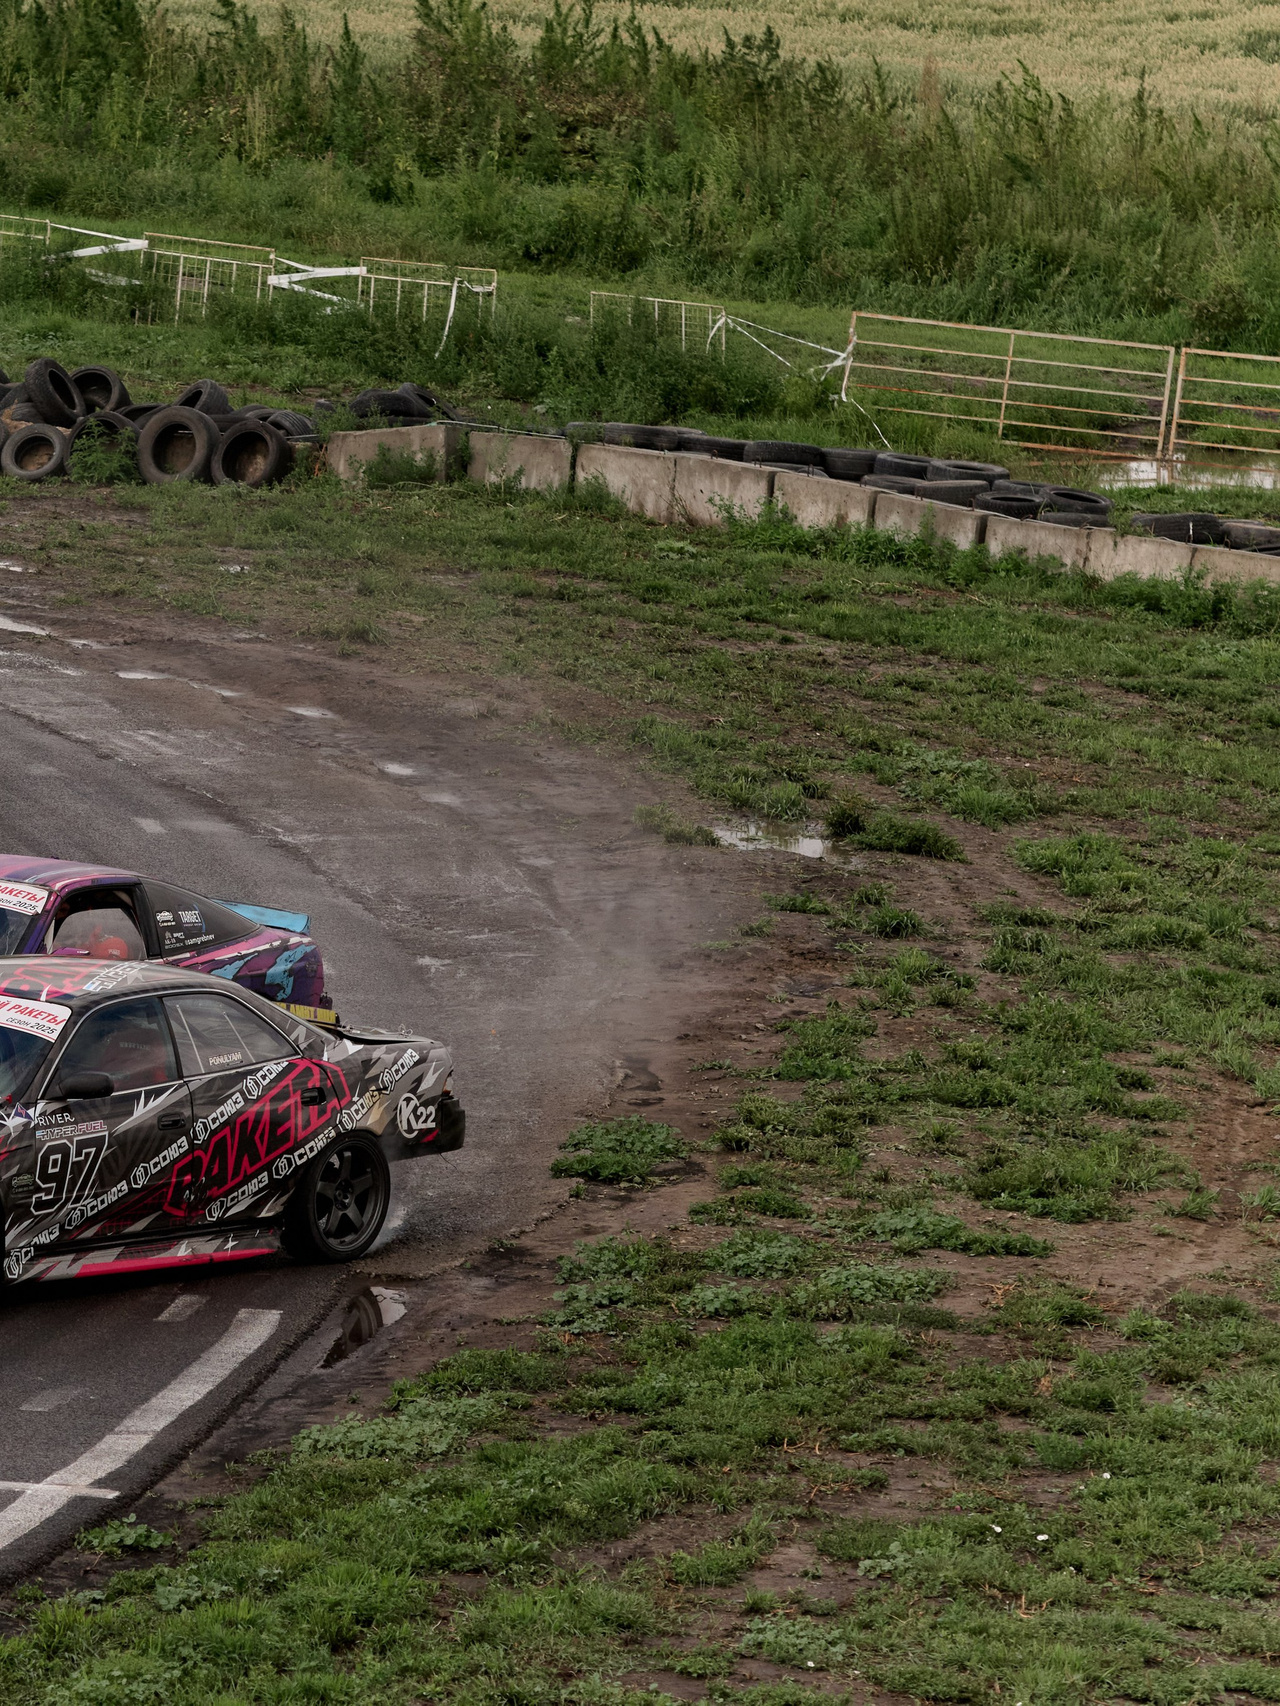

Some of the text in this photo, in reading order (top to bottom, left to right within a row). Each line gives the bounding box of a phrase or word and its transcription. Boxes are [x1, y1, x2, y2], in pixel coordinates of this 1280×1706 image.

[12, 900, 38, 912] 2025
[178, 910, 202, 923] TARGET
[6, 1016, 58, 1035] СЕЗОН 2025
[7, 1003, 67, 1026] РАКЕТЫ
[208, 1051, 242, 1066] PONULYAM
[37, 1112, 75, 1127] RIVER
[208, 1092, 246, 1130] СОЮЗ
[149, 1135, 190, 1175] СОЮЗ
[30, 1131, 109, 1215] 97
[86, 1180, 128, 1218] СОЮЗ
[226, 1171, 269, 1207] СОЮЗ
